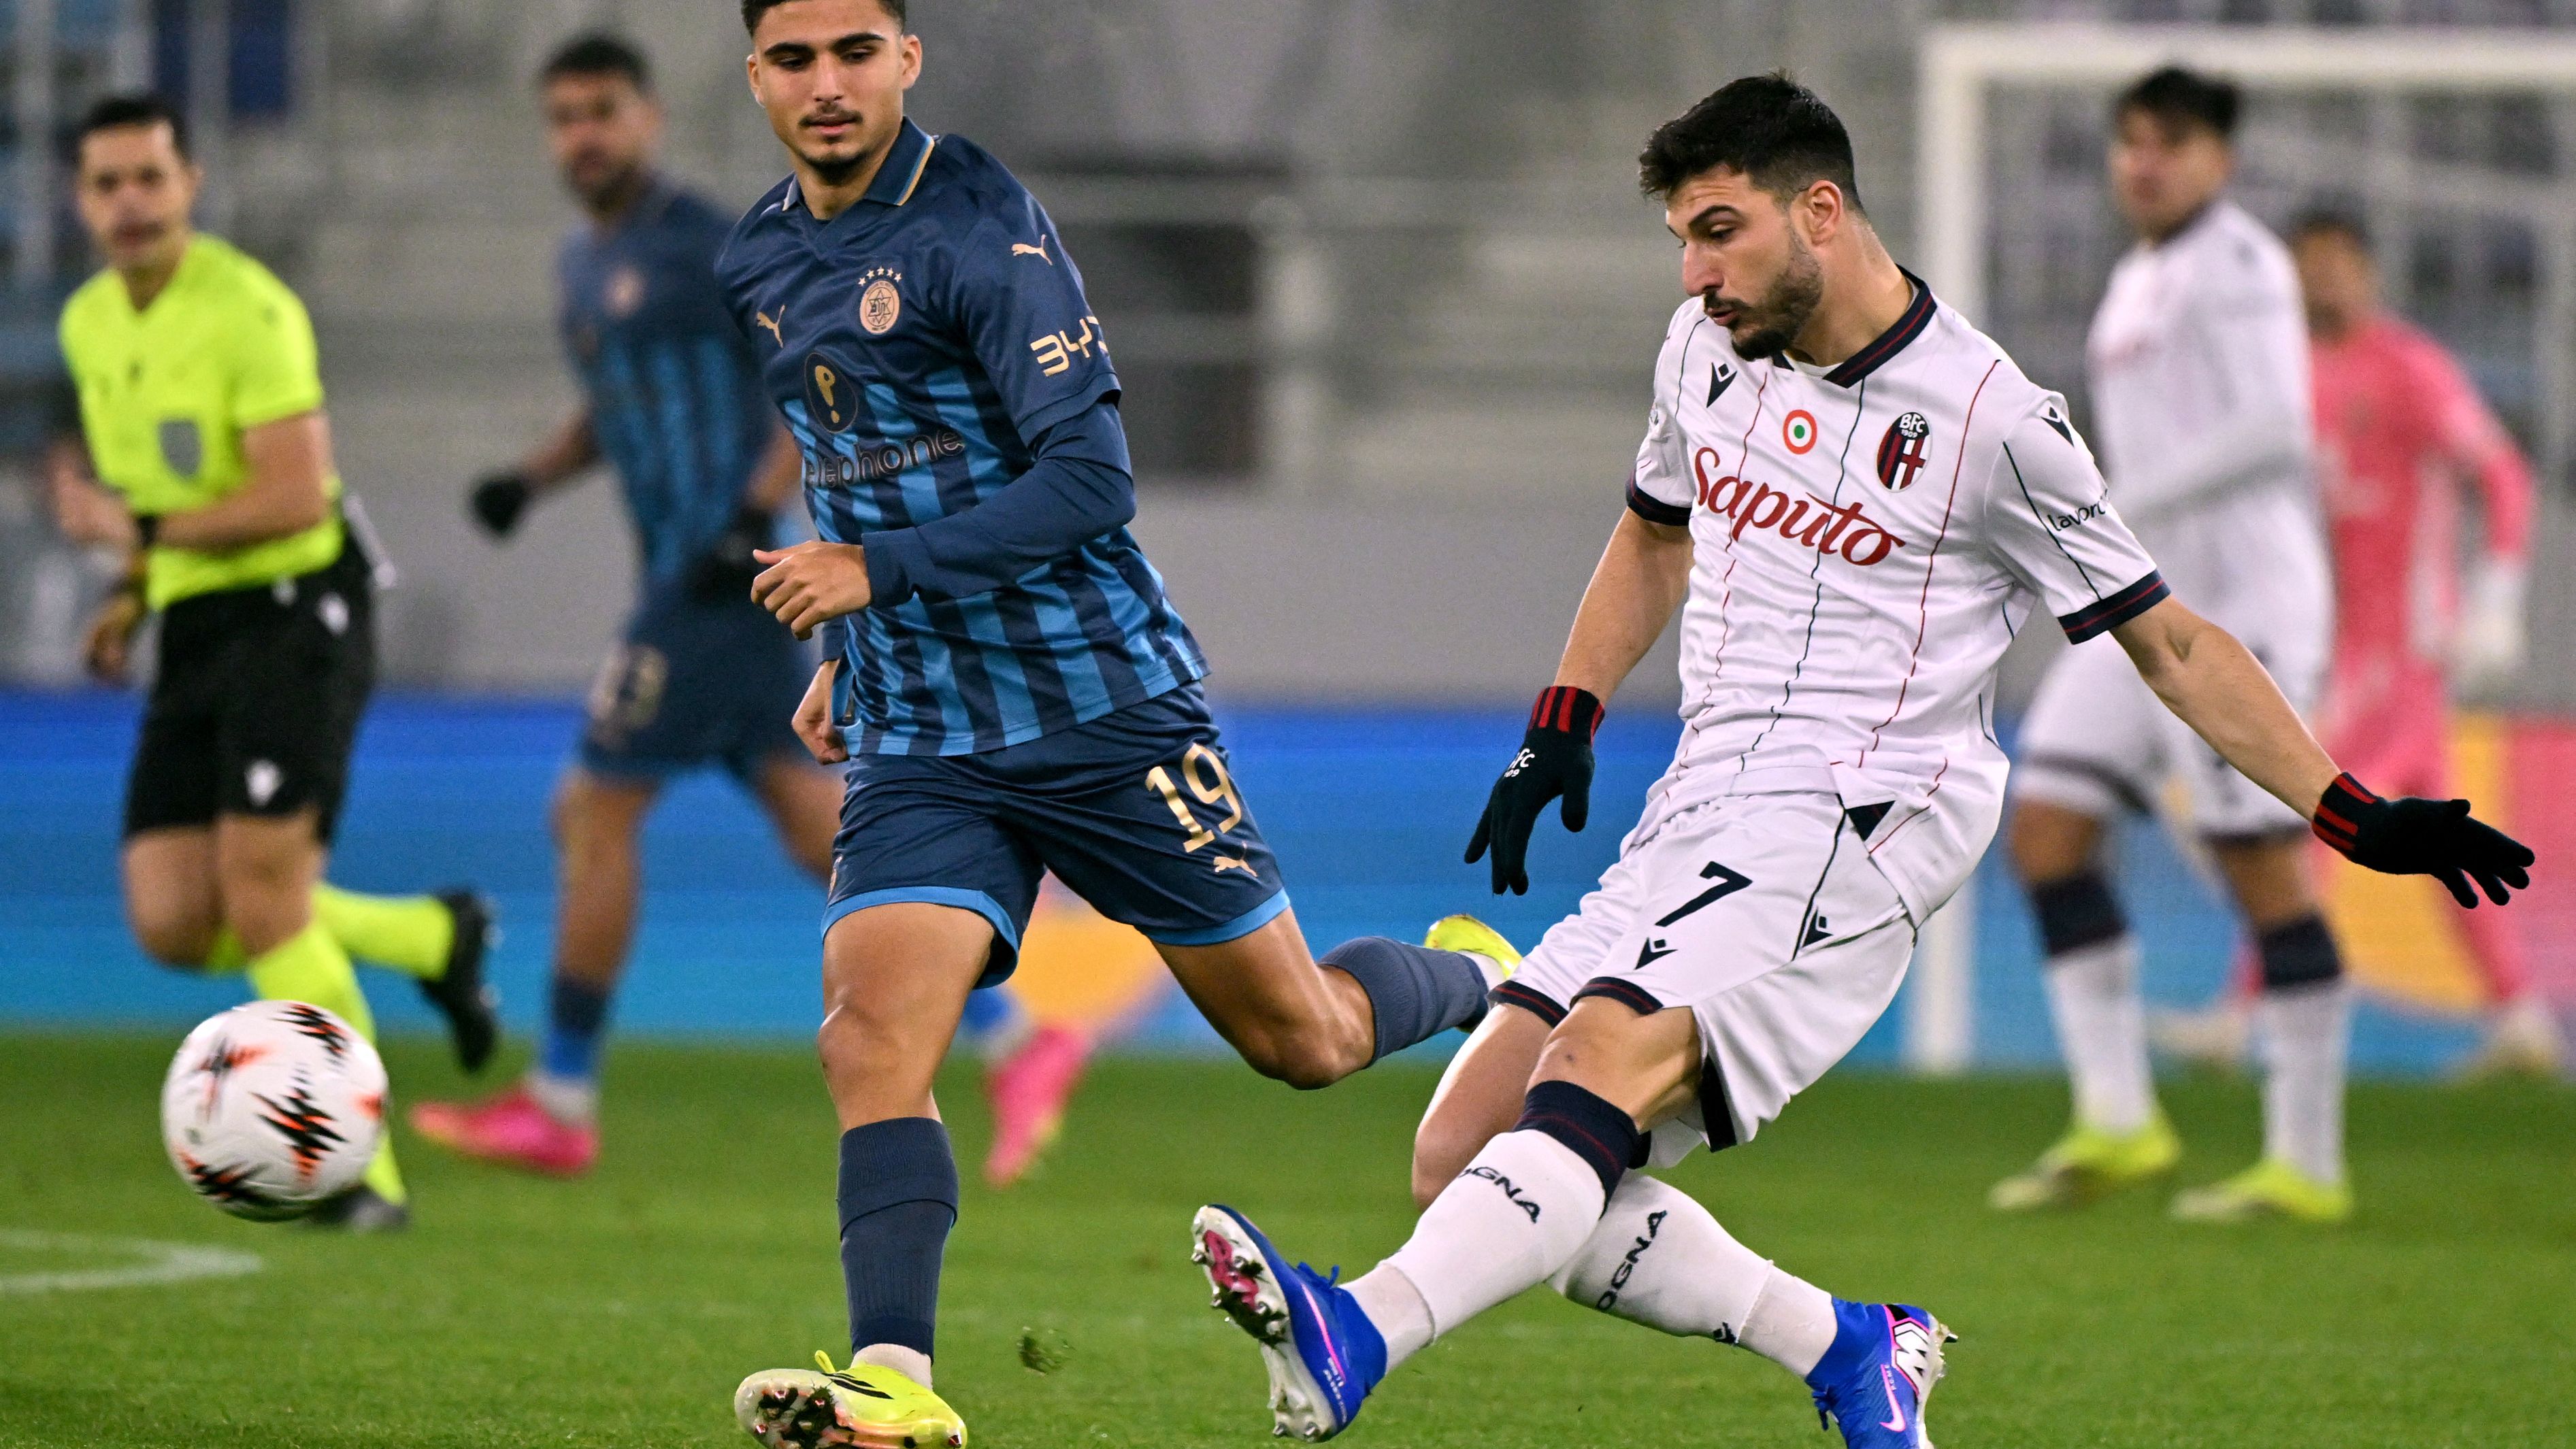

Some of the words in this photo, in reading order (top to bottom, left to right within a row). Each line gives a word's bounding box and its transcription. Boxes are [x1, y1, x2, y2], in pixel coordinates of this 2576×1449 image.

[1899, 414, 1926, 433] BFC
[1695, 447, 1906, 566] Saputo
[1507, 748, 1536, 770] FC
[1145, 742, 1242, 852] 19
[1654, 861, 1753, 927] 7
